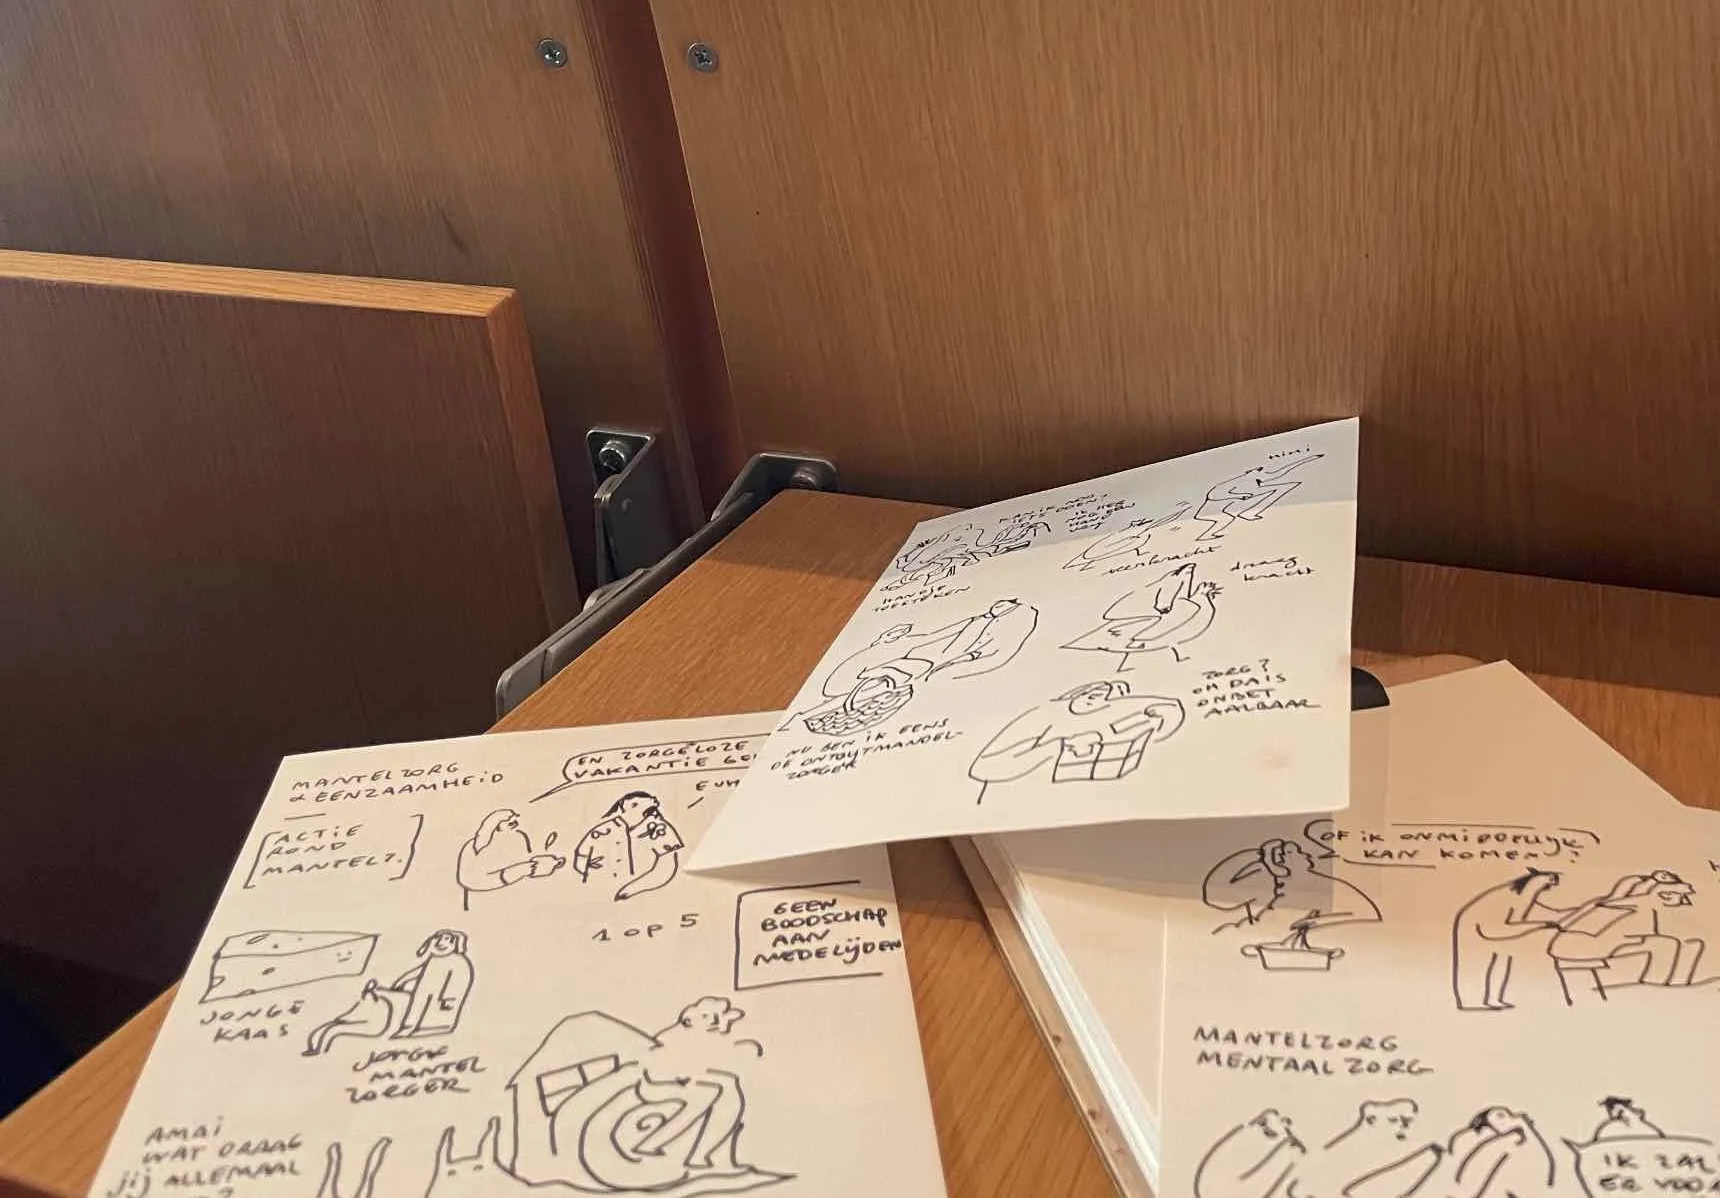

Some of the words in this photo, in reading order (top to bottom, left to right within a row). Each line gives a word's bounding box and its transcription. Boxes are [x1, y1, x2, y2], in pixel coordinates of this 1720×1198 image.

[577, 756, 603, 766] EN
[1320, 831, 1350, 843] OF
[1363, 849, 1420, 859] KAN
[773, 898, 838, 915] GEEN
[592, 928, 611, 941] 1
[680, 913, 700, 927] 5
[761, 907, 889, 932] BOODSCHAP
[771, 929, 831, 947] AAN
[200, 1000, 305, 1025] JONGE
[212, 1023, 289, 1043] KAAS
[1193, 1025, 1399, 1052] MANTELZORG
[1599, 1173, 1643, 1192] ER
